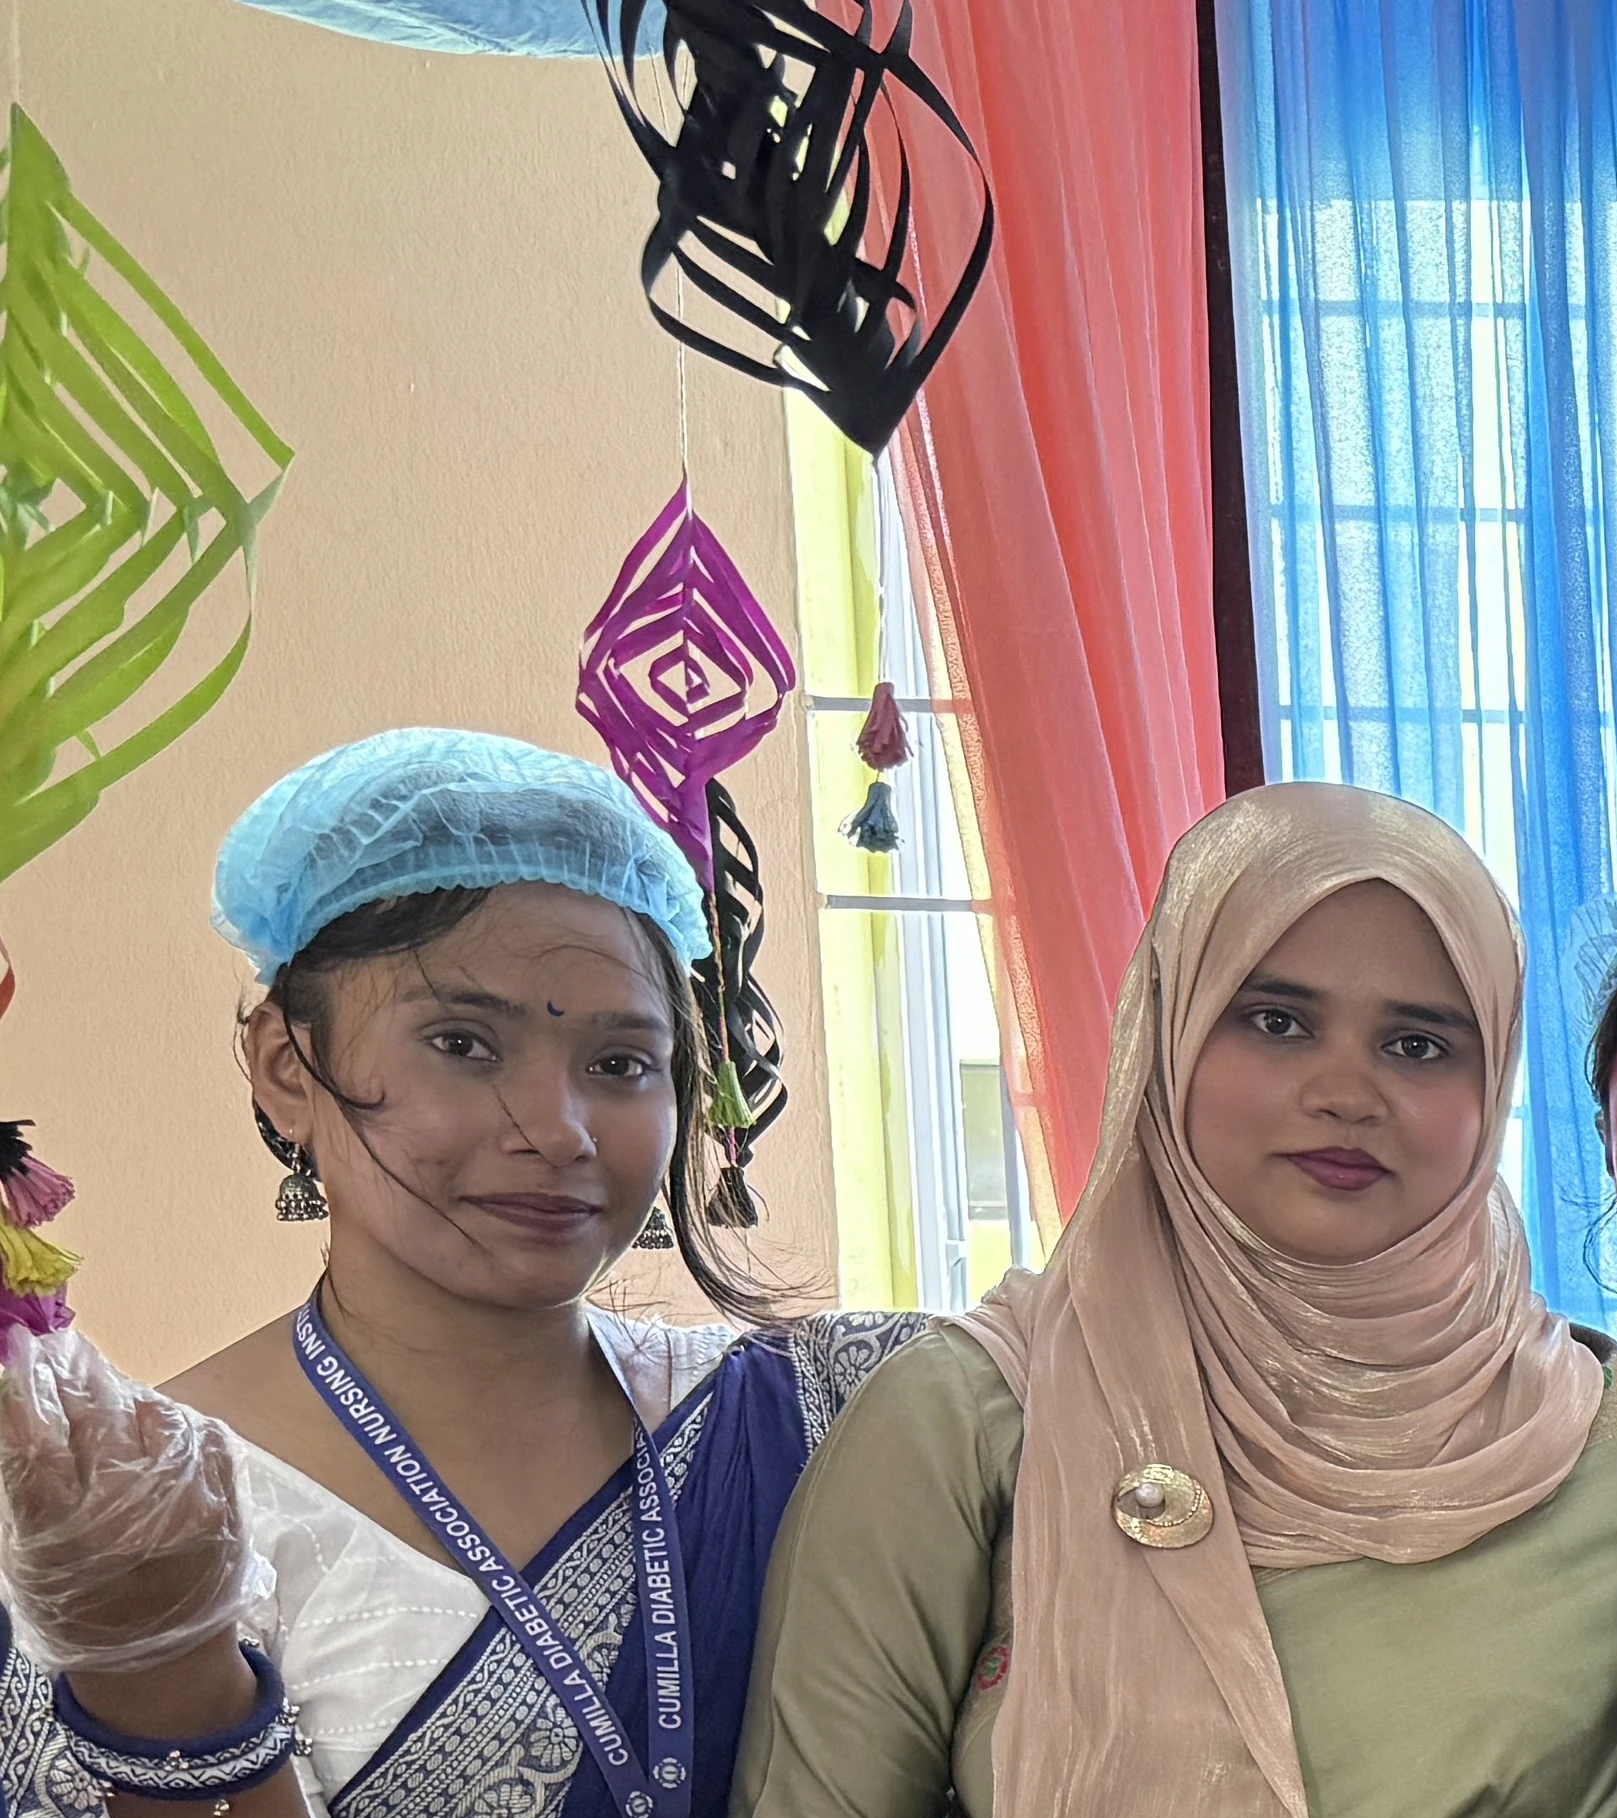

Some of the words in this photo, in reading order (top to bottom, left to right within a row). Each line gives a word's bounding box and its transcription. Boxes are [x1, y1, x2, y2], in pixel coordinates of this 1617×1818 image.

[316, 1356, 397, 1445] NURSING
[384, 1444, 504, 1572] ASSOCIATION
[491, 1575, 573, 1670] DIABETIC
[642, 1527, 677, 1625] DIABETIC
[563, 1670, 629, 1766] CUMILLA
[658, 1630, 682, 1730] CUMILLA
